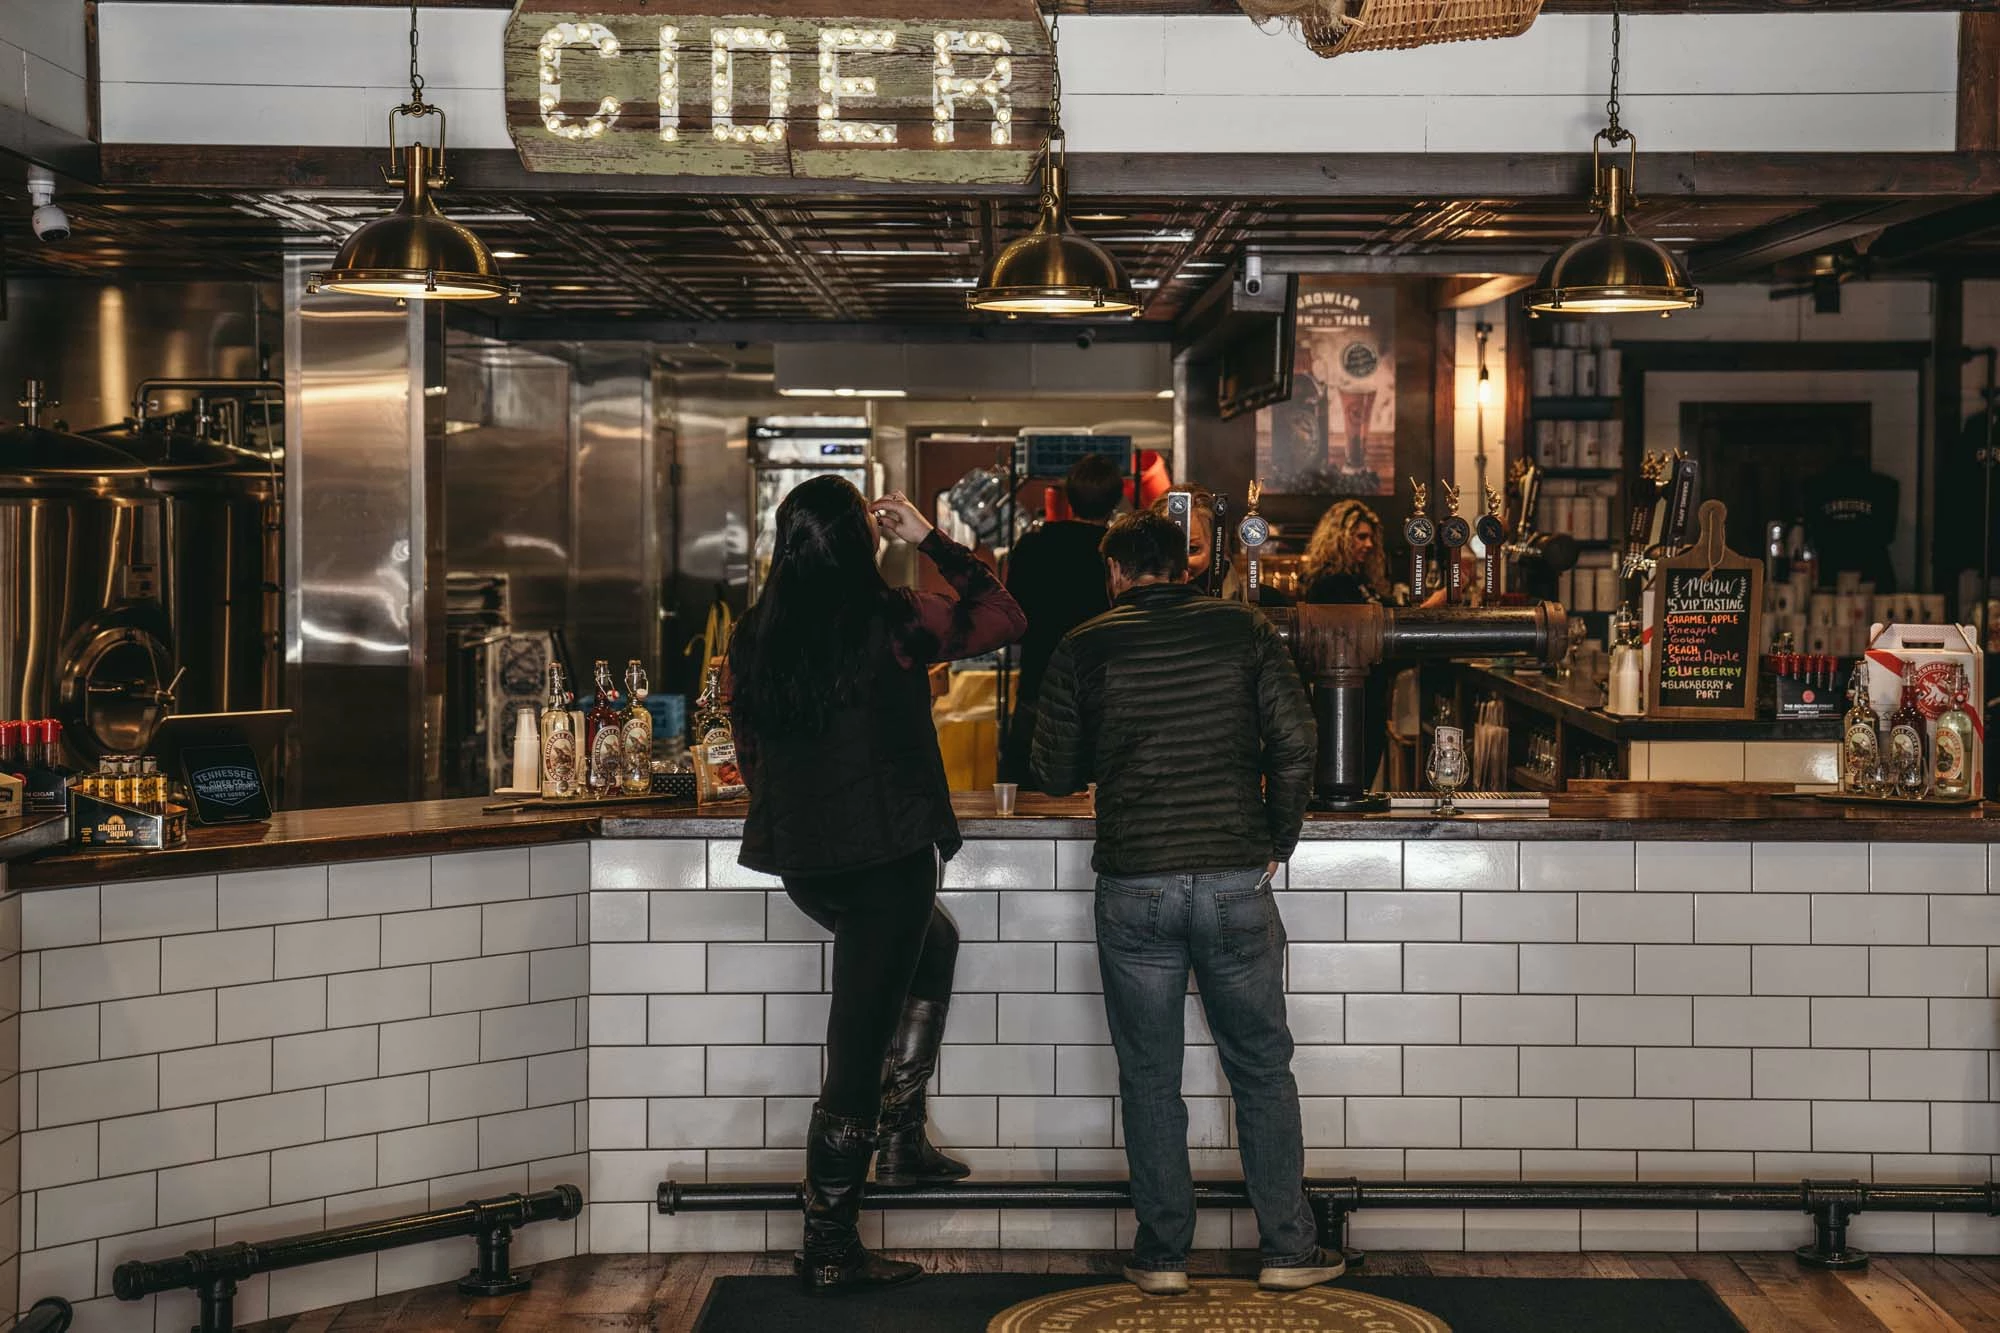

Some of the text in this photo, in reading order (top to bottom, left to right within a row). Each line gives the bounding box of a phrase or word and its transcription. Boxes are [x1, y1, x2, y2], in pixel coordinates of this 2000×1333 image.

[539, 22, 1012, 143] CIDER
[1297, 292, 1360, 310] GROWLER
[1335, 315, 1370, 326] TABLE
[1415, 554, 1423, 595] BLUEBERRY
[1682, 577, 1738, 598] Menu
[1680, 598, 1700, 610] VIP
[1701, 598, 1744, 611] TASTING
[1667, 614, 1739, 625] CARAMEL APPLE
[1668, 625, 1718, 636] Pineapple
[1670, 634, 1706, 644] Golden
[1668, 644, 1698, 655] PEACH
[1669, 649, 1740, 665] Spiced Apple
[1668, 666, 1742, 677] BLUEBERRY
[1668, 680, 1724, 690] BLACKBERRY
[1696, 690, 1721, 699] PORT
[196, 769, 253, 783] TENNESSEE
[98, 823, 127, 834] cigarro
[109, 830, 134, 840] agave
[1252, 1291, 1376, 1319] CIDER
[1136, 1308, 1297, 1316] MERCHANTS
[1116, 1317, 1320, 1326] OF SPIRITED
